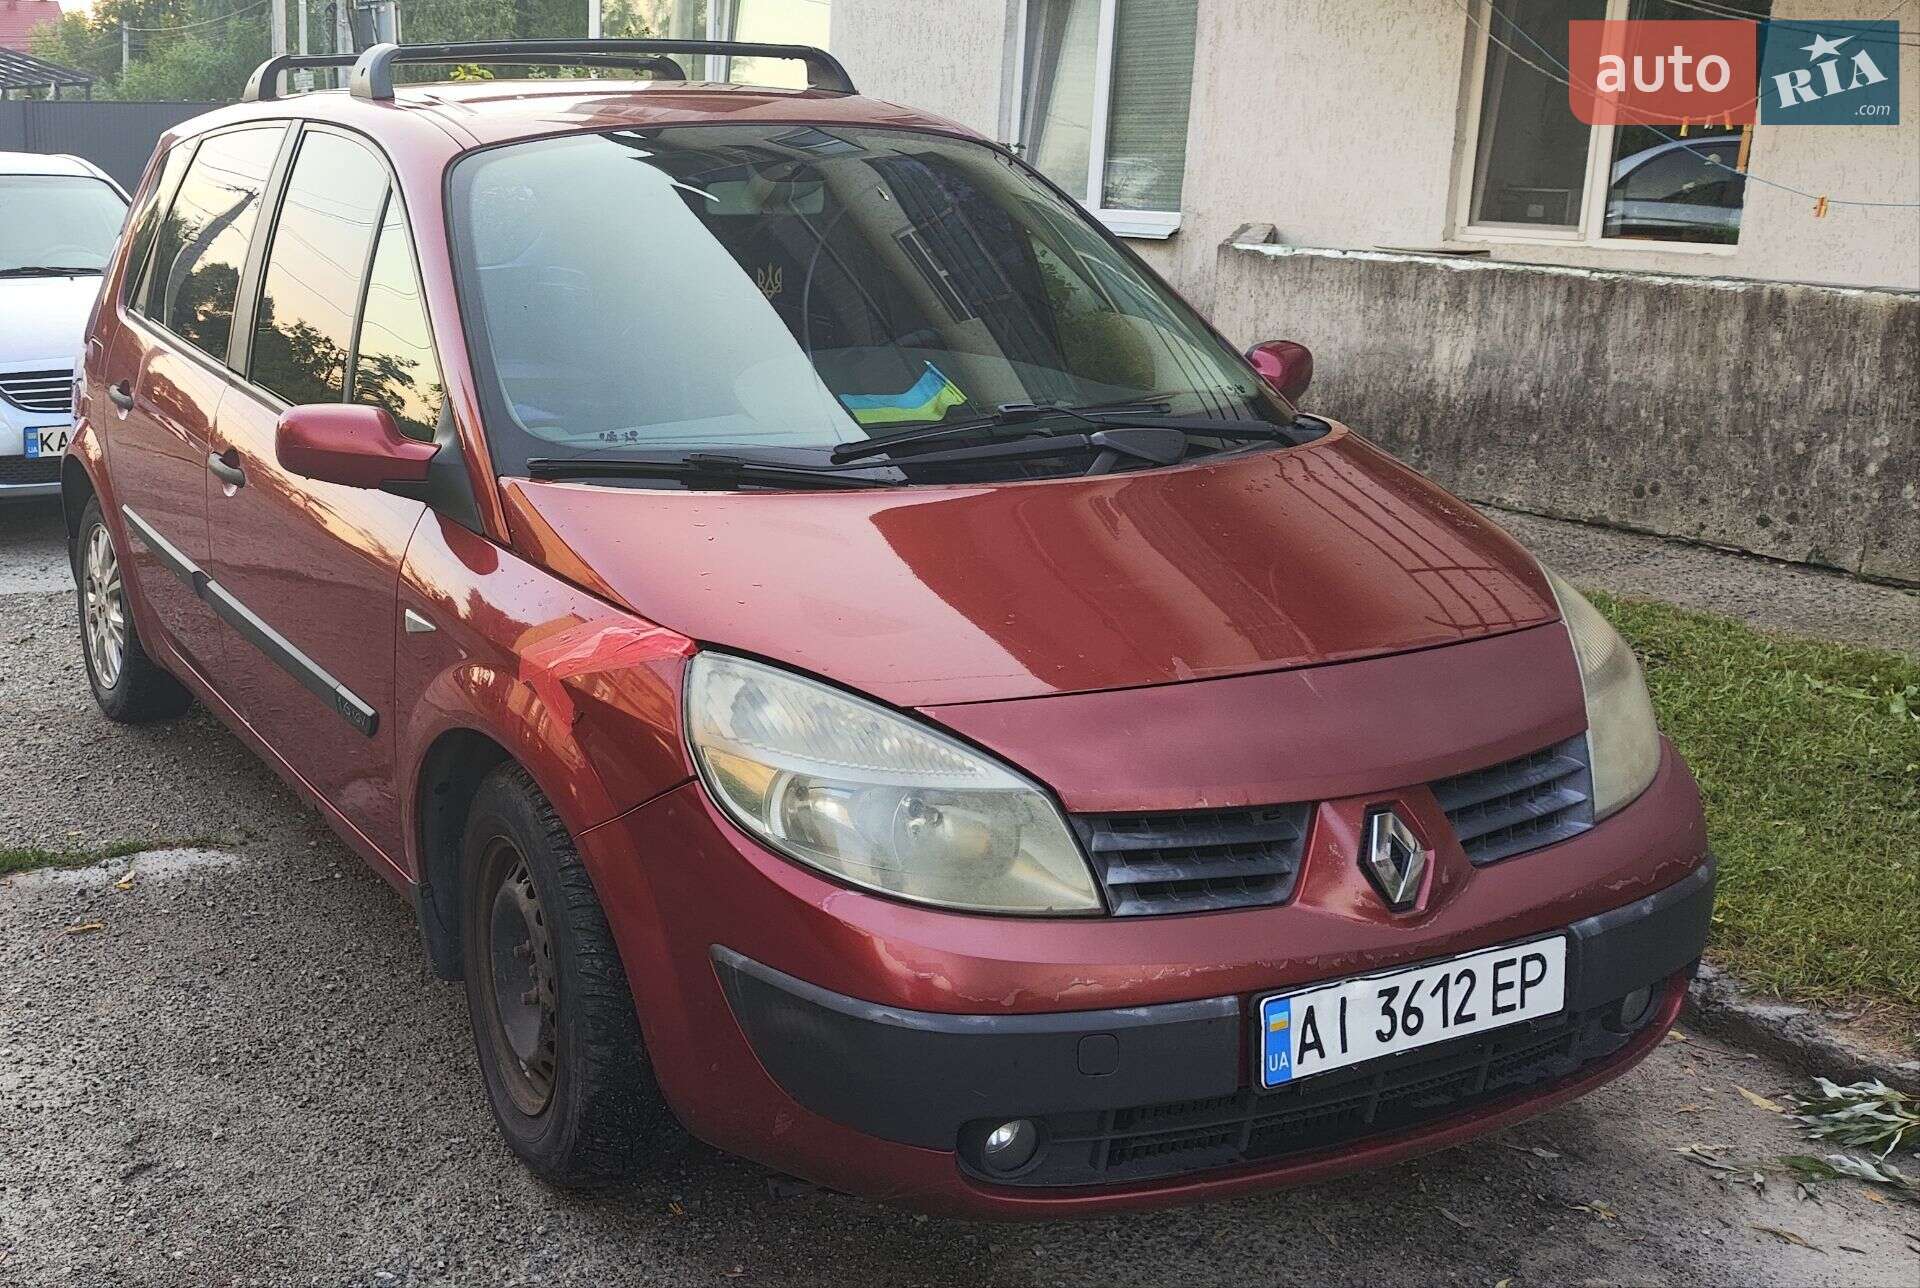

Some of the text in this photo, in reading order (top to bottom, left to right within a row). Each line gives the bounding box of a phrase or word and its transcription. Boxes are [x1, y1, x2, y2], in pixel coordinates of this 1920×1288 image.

[39, 431, 69, 453] KA
[1297, 952, 1548, 1065] AI 3612 EP
[1268, 1051, 1290, 1073] UA
